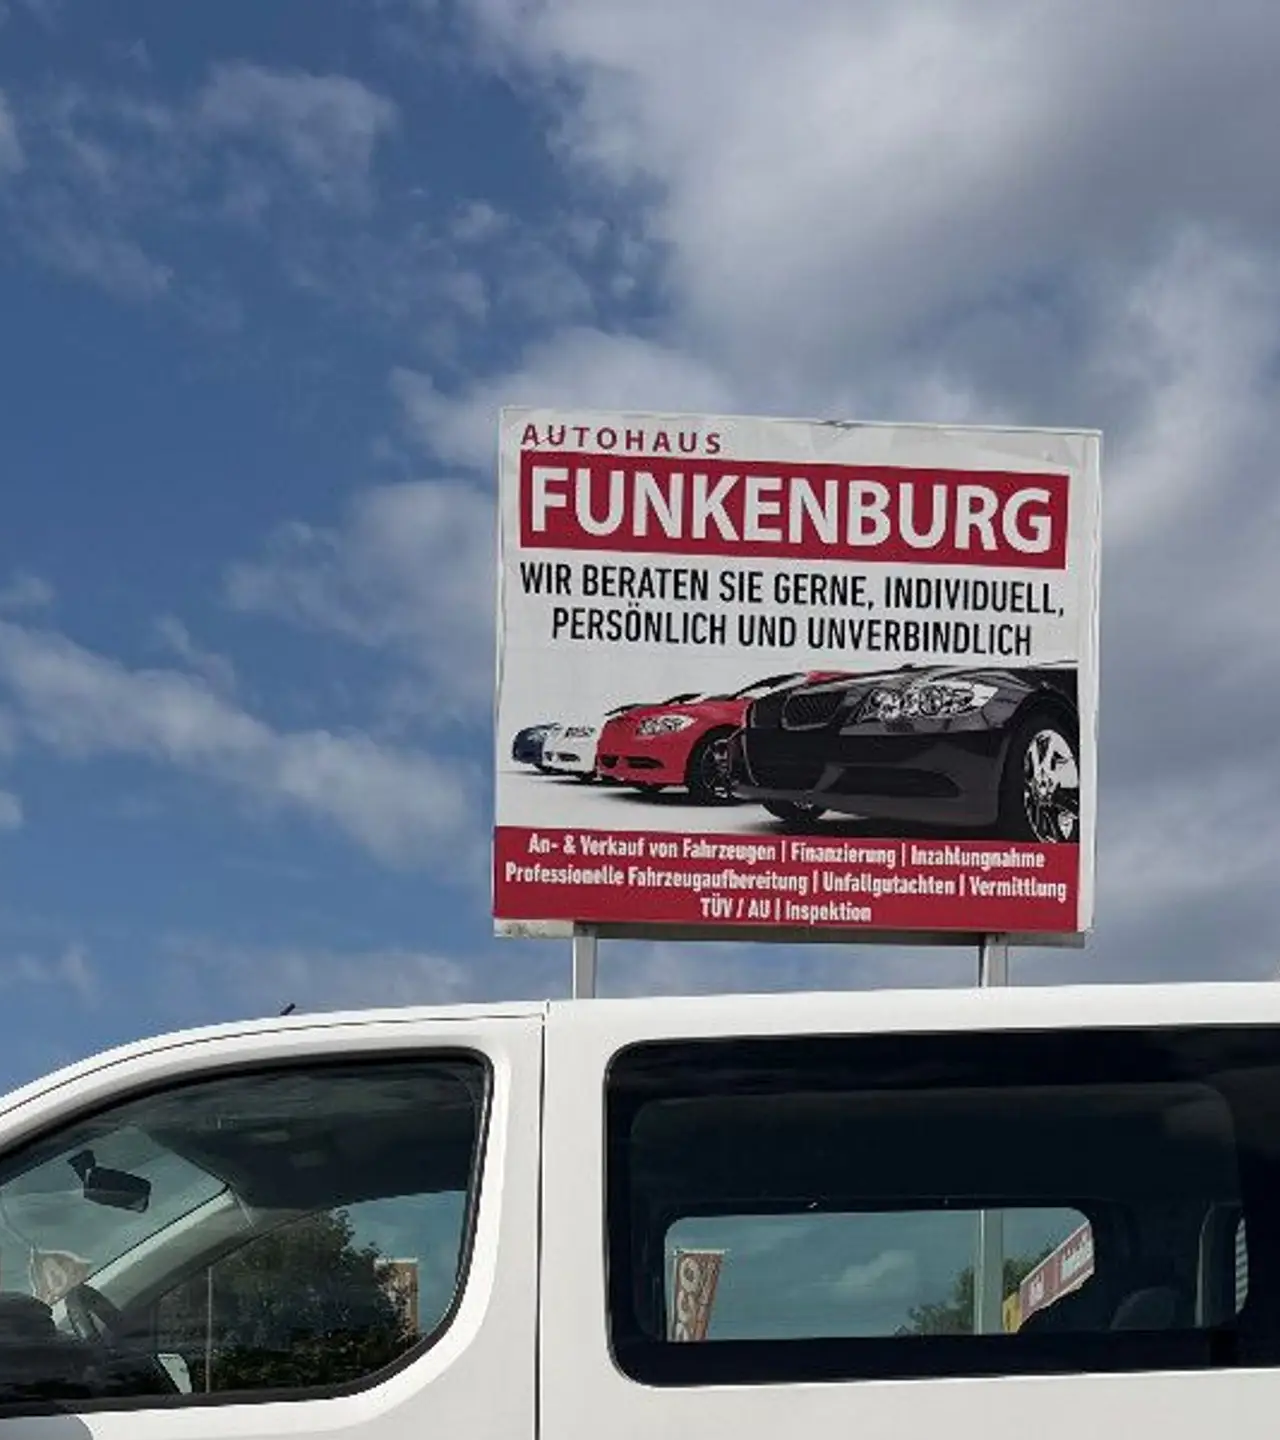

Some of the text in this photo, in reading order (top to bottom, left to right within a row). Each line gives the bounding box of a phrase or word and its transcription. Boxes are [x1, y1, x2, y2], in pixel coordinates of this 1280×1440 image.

[520, 424, 721, 455] AUTOHAUS
[531, 465, 1052, 554] FUNKENBURG
[519, 562, 1065, 617] WIR BERATEN SIE GERNE, INDIVIDUELL,
[552, 602, 1032, 655] PERSÖNLICH UND UNVERBINDLICH
[528, 833, 559, 854] An-
[563, 834, 577, 855] &
[580, 836, 645, 857] Verkauf
[649, 841, 679, 858] von
[683, 838, 776, 866] Fahrzeugen
[791, 842, 897, 869] Finanzierung
[911, 844, 1046, 871] Inzahlungnahme
[505, 861, 625, 886] Professionelle
[628, 865, 808, 897] Fahrzeugaufbereitung
[823, 871, 956, 897] Unfallgutachten
[969, 875, 1068, 903] Vermittlung
[700, 893, 733, 918] TÜV
[747, 897, 770, 920] AU
[785, 898, 872, 925] Inspektion
